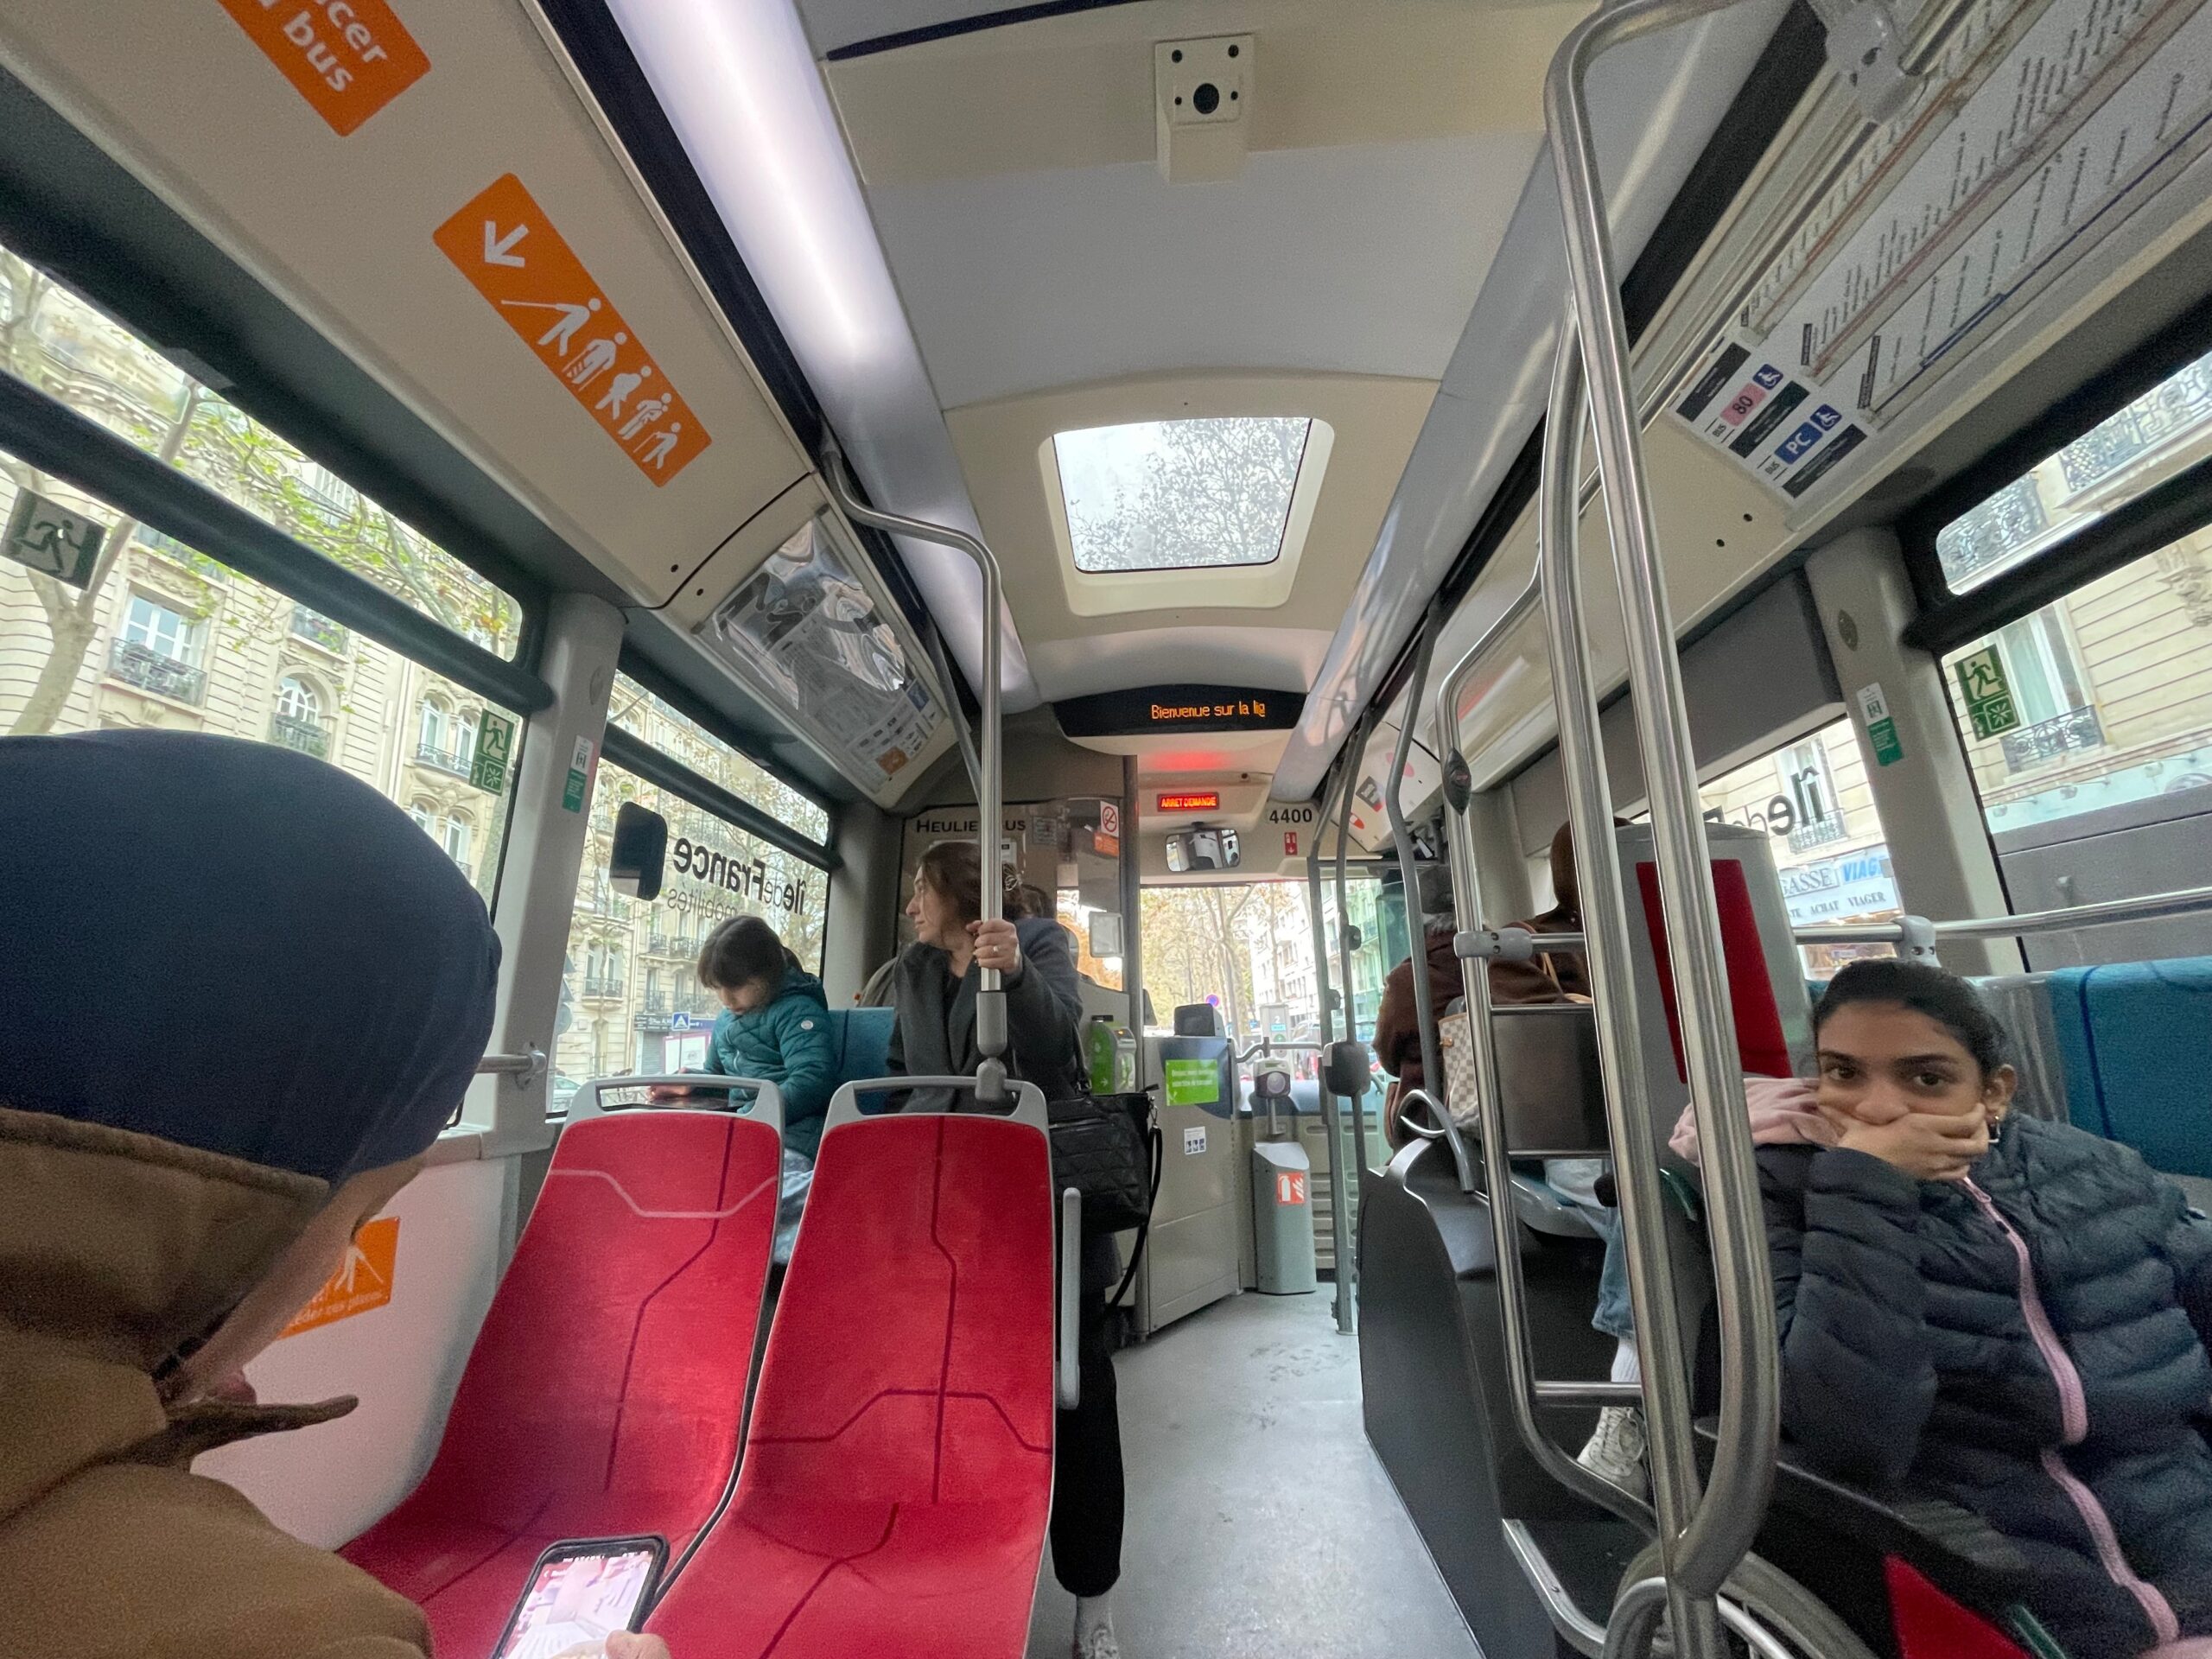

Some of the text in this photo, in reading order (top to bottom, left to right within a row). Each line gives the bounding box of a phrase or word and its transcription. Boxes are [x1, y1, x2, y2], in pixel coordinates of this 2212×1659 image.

[315, 0, 388, 63] cer
[283, 10, 353, 92] bus
[1732, 395, 1754, 416] 80
[1785, 432, 1812, 454] PC
[1151, 704, 1210, 720] Bienvenue
[1214, 705, 1235, 716] sur
[1239, 701, 1249, 715] la
[1161, 797, 1183, 808] ARRET
[1268, 808, 1313, 824] 4400
[916, 819, 979, 833] HEULIE
[1005, 820, 1027, 831] US
[1847, 892, 1886, 907] VIAGER
